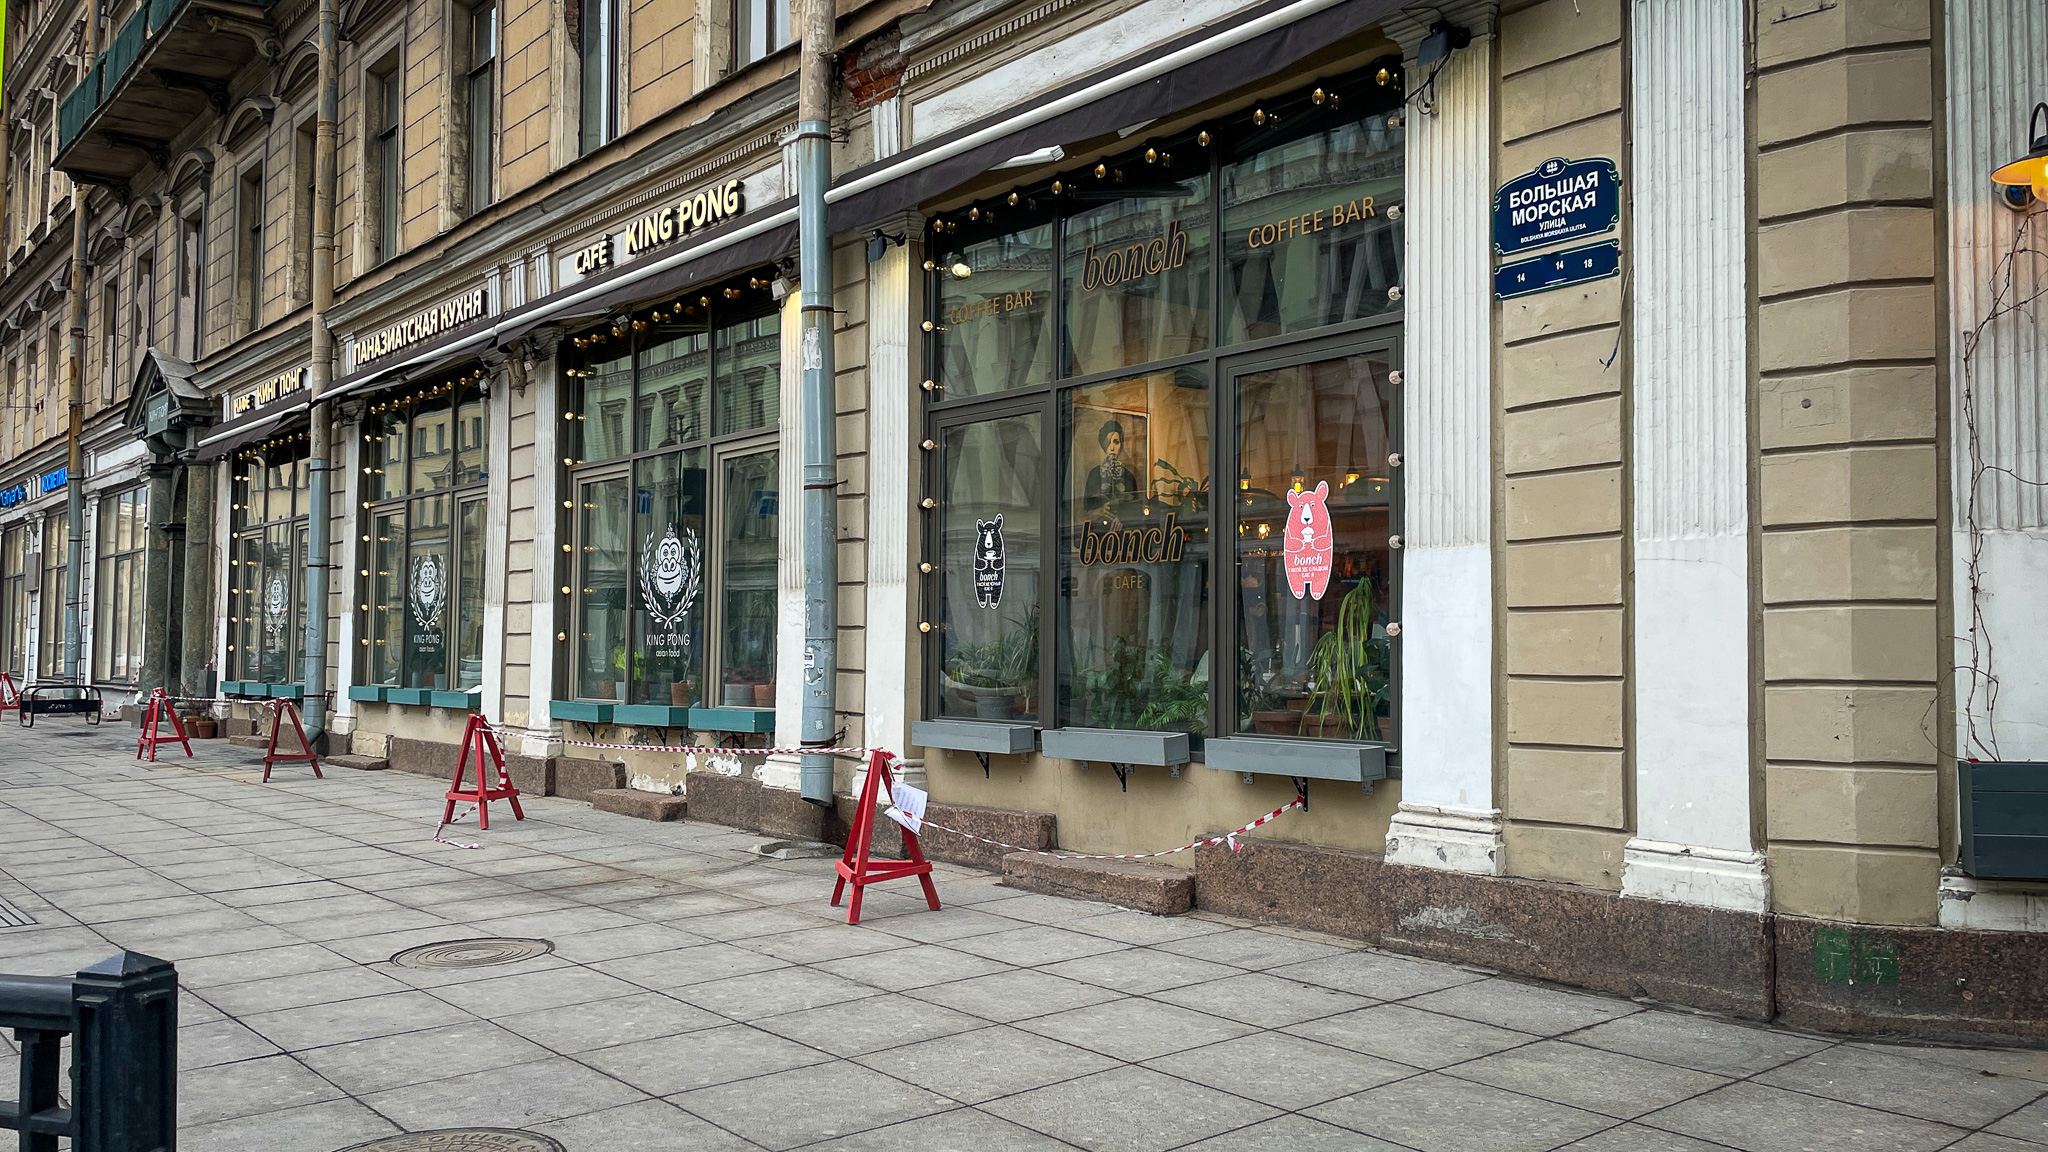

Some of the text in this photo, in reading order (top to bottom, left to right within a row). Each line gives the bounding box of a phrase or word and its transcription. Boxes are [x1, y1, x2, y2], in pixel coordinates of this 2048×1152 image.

[1509, 171, 1599, 208] БОЛЬШАЯ
[1248, 195, 1375, 248] COFFEE BAR
[1512, 191, 1596, 226] МОРСКАЯ
[1539, 217, 1566, 231] УЛИЦА
[574, 179, 740, 274] CAFÉ KING PONG
[1081, 219, 1187, 291] bonch
[1517, 259, 1593, 283] 14 14 18
[950, 289, 1033, 325] COFFEE BAR
[353, 289, 482, 366] ПАНАЗИАТСКАЯ КУХНЯ
[256, 378, 278, 405] КИНГ
[280, 369, 303, 397] ПОНГ
[1080, 512, 1184, 567] bonch
[980, 571, 998, 581] bonch
[1294, 553, 1322, 566] bonch
[1113, 575, 1143, 589] CAFE
[426, 634, 440, 644] PONG
[646, 633, 690, 646] KING PONG
[668, 648, 680, 657] food
